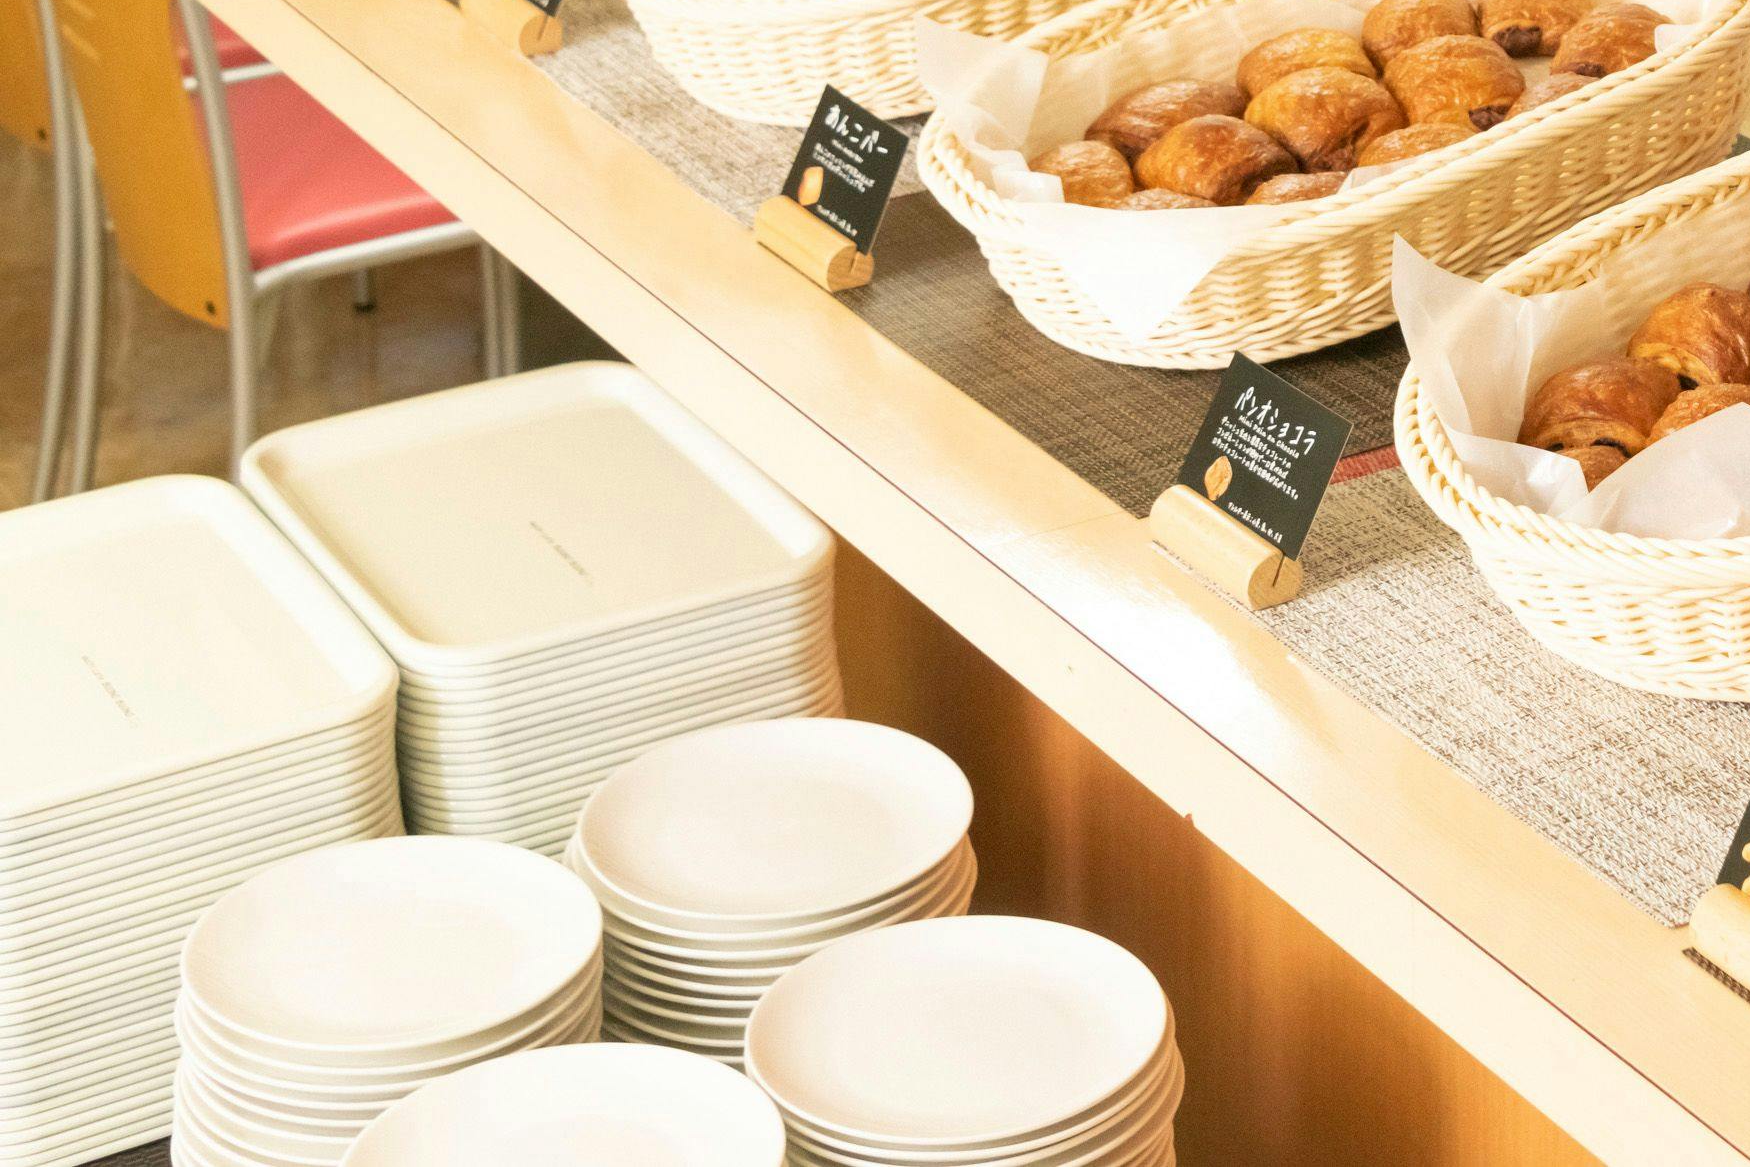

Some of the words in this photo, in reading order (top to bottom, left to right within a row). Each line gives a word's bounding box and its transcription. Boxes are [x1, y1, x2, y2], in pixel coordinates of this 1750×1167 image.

[1233, 385, 1317, 455] パンオショコラ
